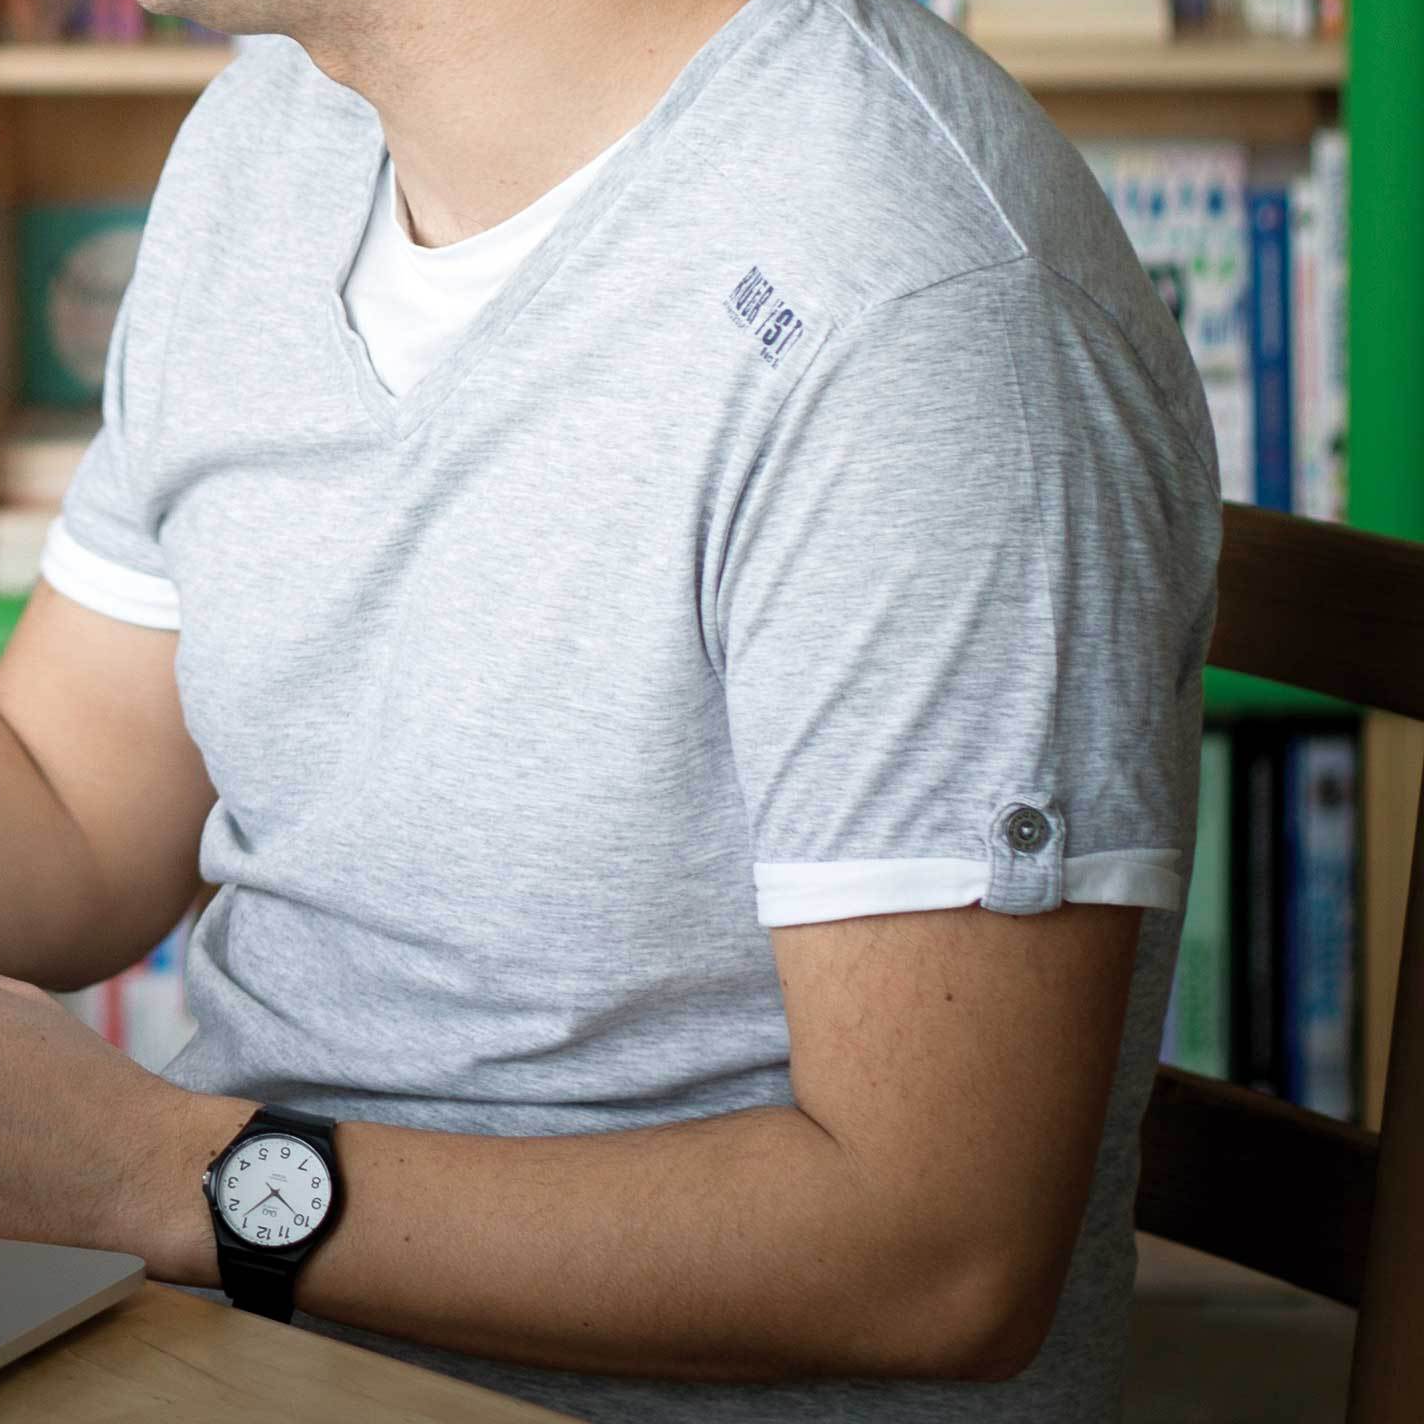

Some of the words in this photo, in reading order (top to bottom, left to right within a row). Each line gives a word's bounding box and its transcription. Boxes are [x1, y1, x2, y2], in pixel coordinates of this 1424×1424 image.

[258, 1148, 269, 1161] 5
[280, 1147, 292, 1160] 6
[239, 1159, 252, 1172] 4
[297, 1158, 310, 1172] 7
[227, 1176, 239, 1189] 3
[311, 1176, 321, 1189] 8
[229, 1198, 240, 1212] 2
[311, 1197, 322, 1209] 9
[241, 1217, 248, 1229] 1
[293, 1213, 310, 1228] 10
[256, 1225, 272, 1240] 12
[278, 1225, 290, 1239] 11
